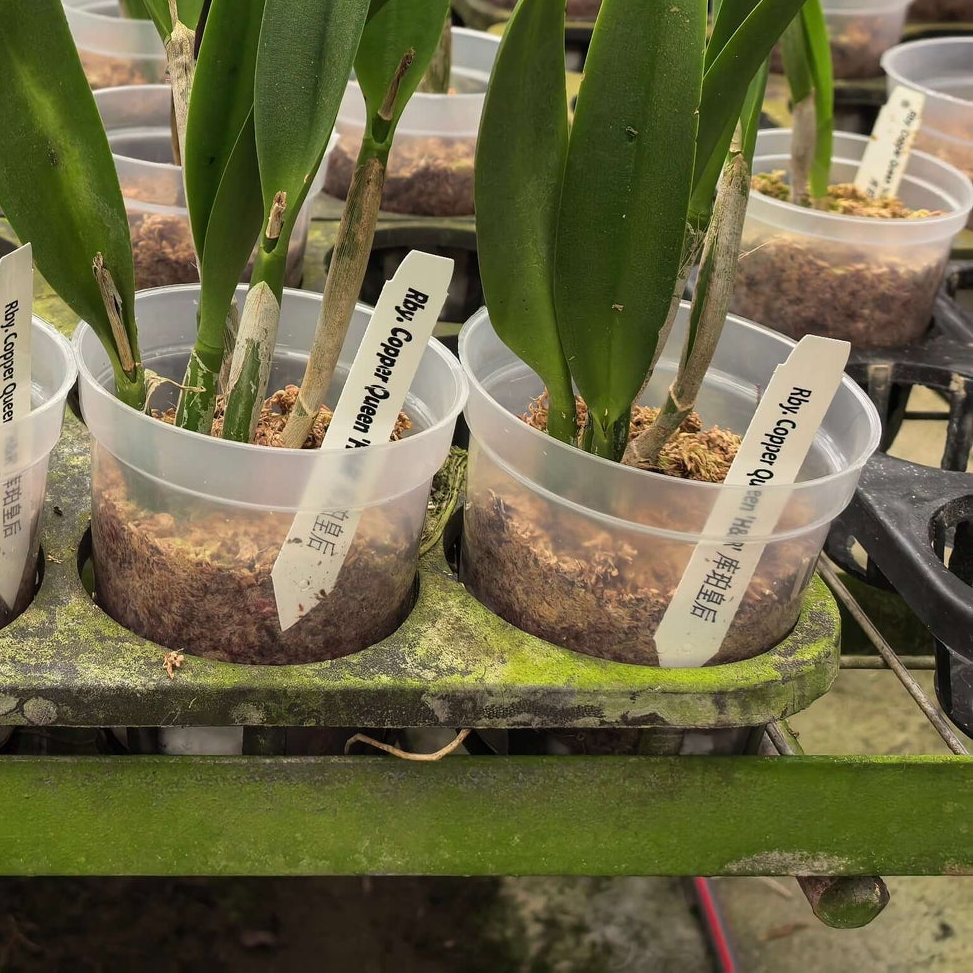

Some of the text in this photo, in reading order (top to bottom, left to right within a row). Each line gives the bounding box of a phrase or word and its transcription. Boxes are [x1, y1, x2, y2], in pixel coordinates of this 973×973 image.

[0, 299, 19, 333] Rby.
[395, 287, 429, 323] Rby.
[0, 332, 18, 382] Copper
[374, 327, 413, 384] Copper
[353, 384, 390, 434] Queen
[779, 387, 812, 415] Rby.
[760, 419, 796, 466] Copper
[739, 469, 774, 511] Queen
[690, 552, 741, 623] 库珀皇后
